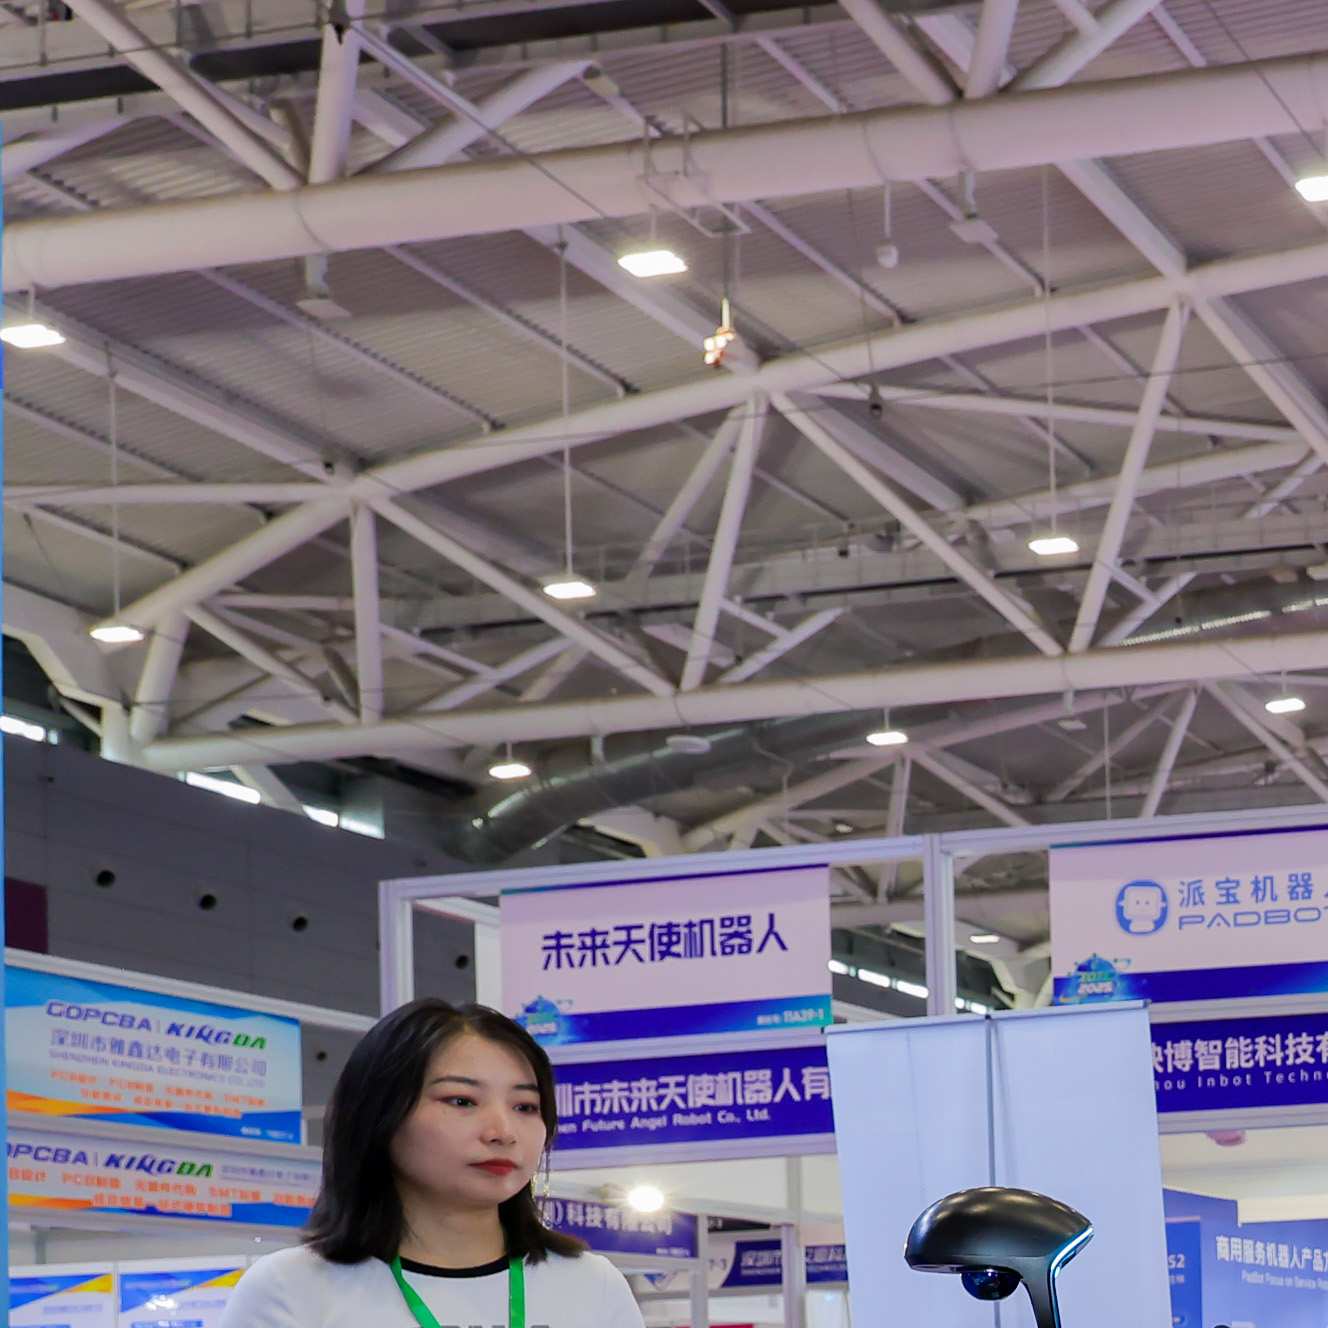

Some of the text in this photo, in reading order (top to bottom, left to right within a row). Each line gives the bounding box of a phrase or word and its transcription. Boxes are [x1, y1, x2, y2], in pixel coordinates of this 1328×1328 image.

[541, 911, 789, 971] 未来天使机器人
[1197, 1073, 1252, 1089] Inbot
[582, 1117, 625, 1133] Future
[630, 1112, 667, 1131] Angel
[672, 1112, 712, 1126] Robot
[746, 1107, 771, 1121] Ltd.
[7, 1142, 89, 1166] PCBA
